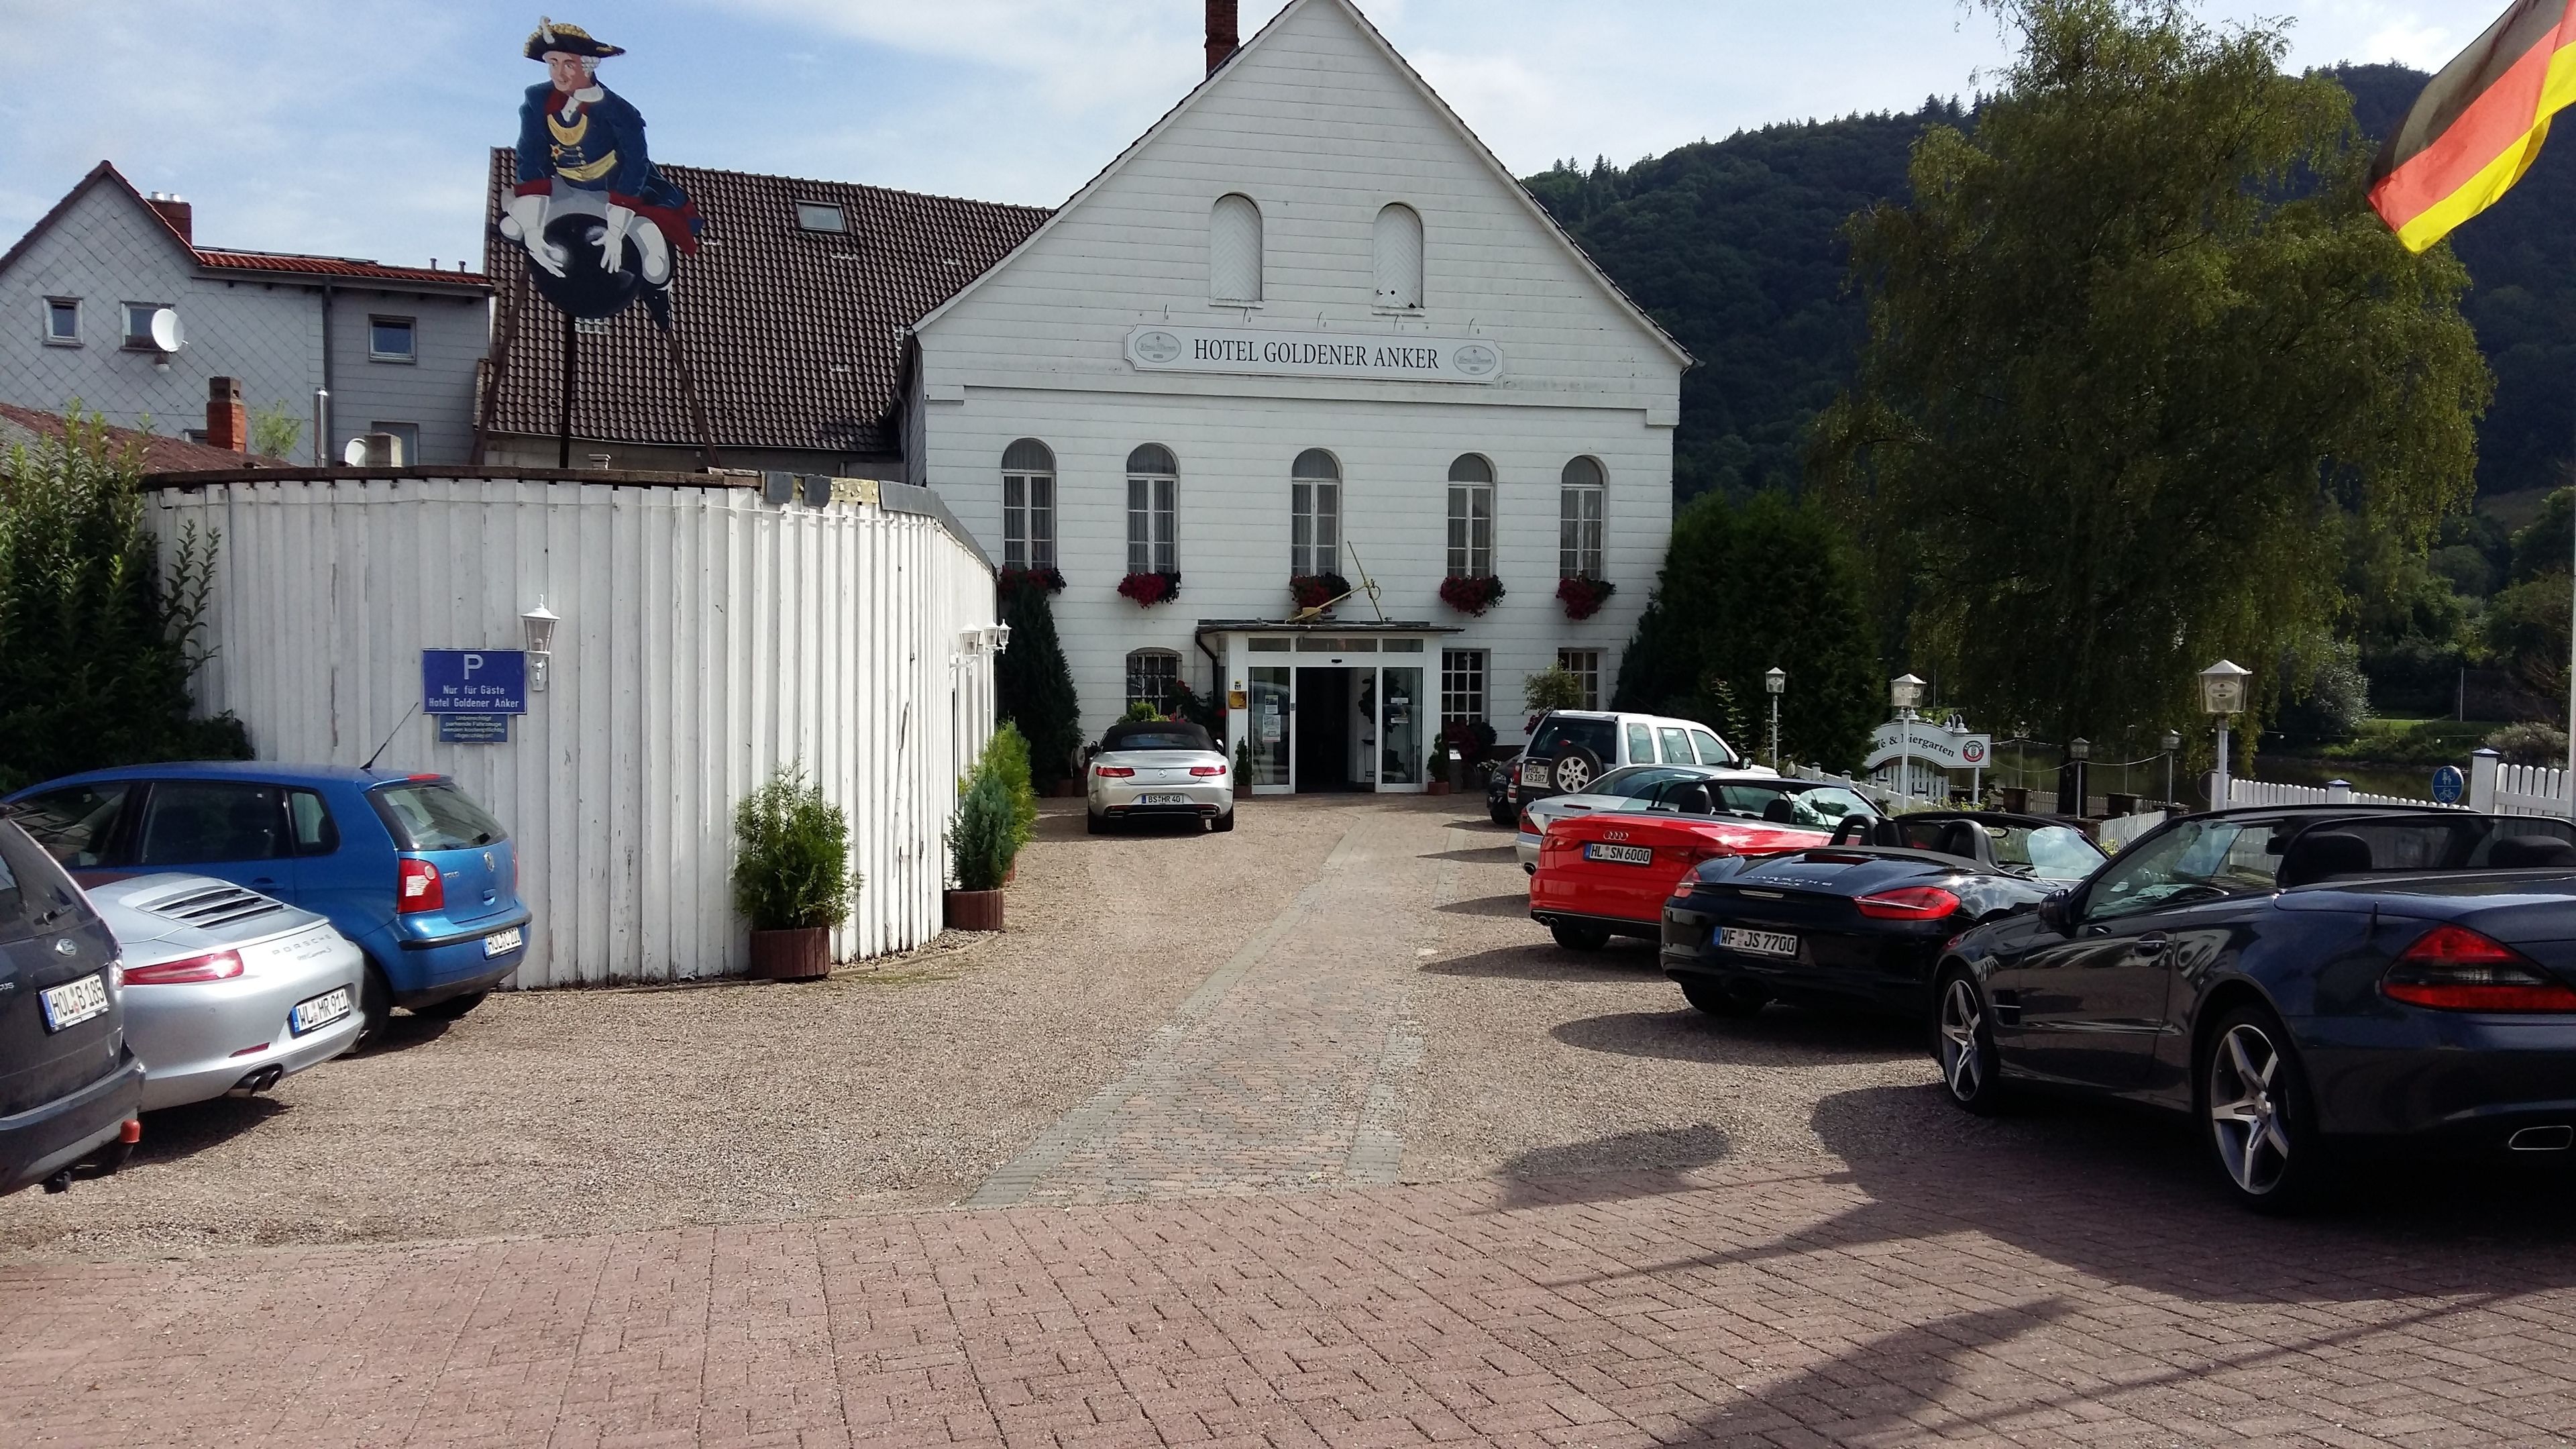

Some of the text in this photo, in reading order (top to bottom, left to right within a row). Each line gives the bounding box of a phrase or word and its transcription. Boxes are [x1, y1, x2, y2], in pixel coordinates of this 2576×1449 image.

[1194, 339, 1259, 362] HOTEL
[1264, 341, 1368, 366] GOLDENER
[1373, 347, 1439, 369] ANKER
[464, 654, 483, 680] P
[443, 685, 504, 694] Nur für Gäste
[429, 698, 519, 708] Hotel Goldener Anker
[1889, 736, 1898, 745] &
[1529, 765, 1540, 773] HOL
[1591, 845, 1650, 862] HL SN 6000
[272, 934, 332, 955] PORSCHE
[486, 933, 502, 951] HOL
[1721, 929, 1736, 945] WF
[1744, 932, 1760, 948] JS
[1763, 934, 1794, 953] 7700
[50, 991, 74, 1020] HOL
[75, 985, 87, 1010] B
[85, 979, 105, 1006] 185
[298, 1006, 314, 1026] WL
[317, 998, 331, 1019] MR
[331, 991, 347, 1014] 911
